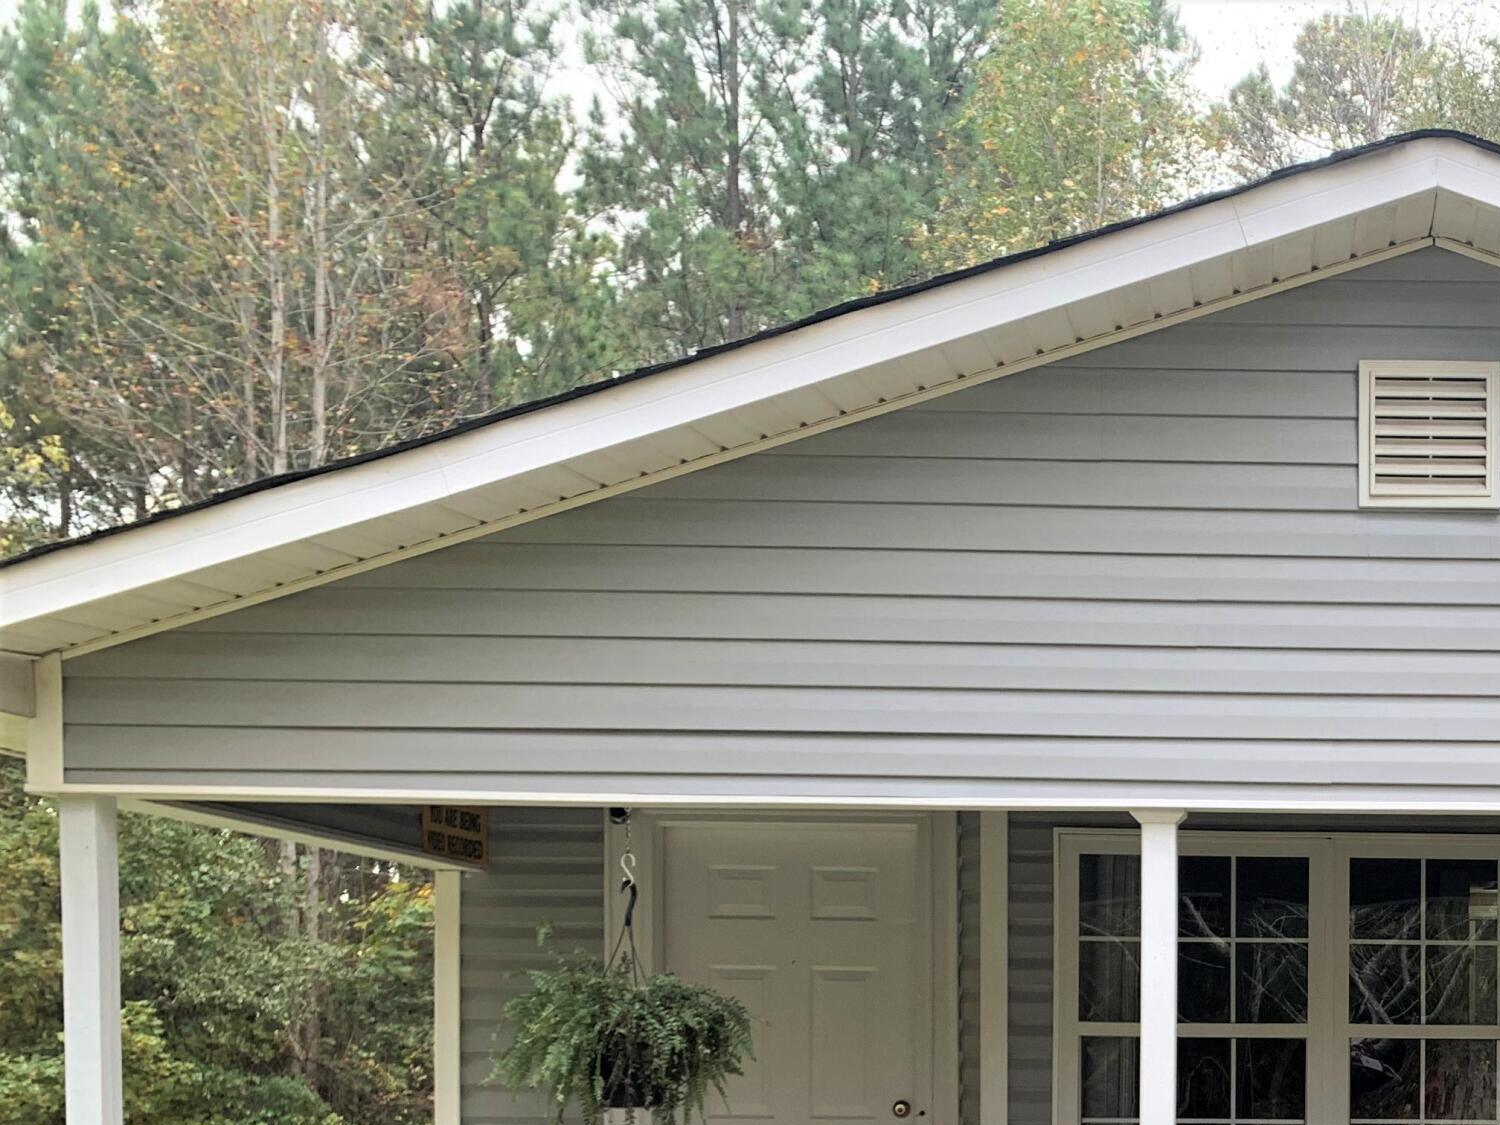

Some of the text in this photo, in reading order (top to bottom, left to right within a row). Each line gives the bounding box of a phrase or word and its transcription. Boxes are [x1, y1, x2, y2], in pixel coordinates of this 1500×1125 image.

[430, 806, 481, 833] YOU ARE BEING
[447, 834, 483, 860] RECORDED
